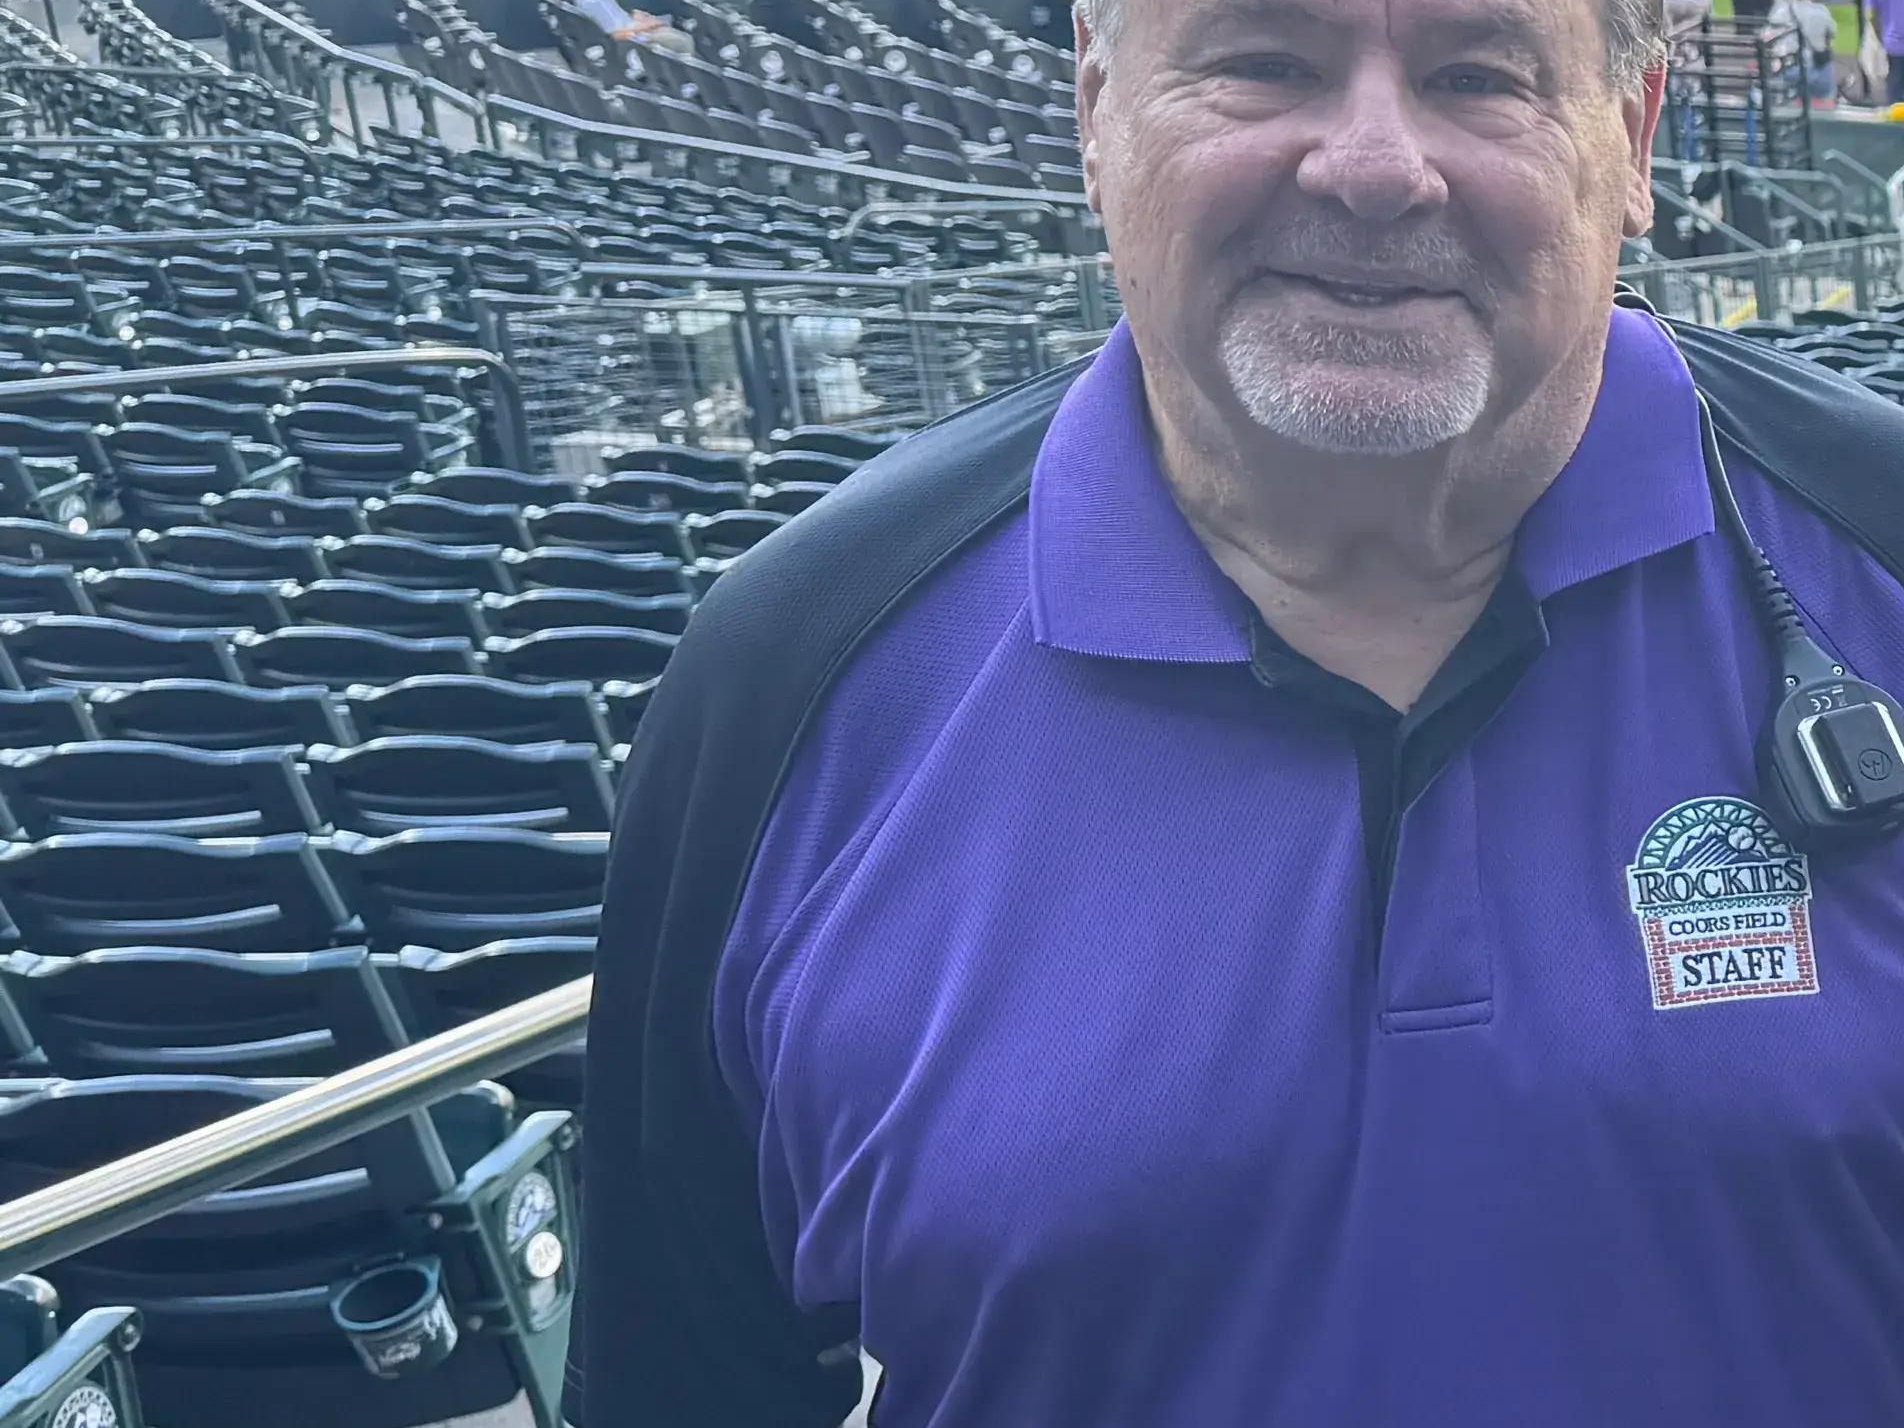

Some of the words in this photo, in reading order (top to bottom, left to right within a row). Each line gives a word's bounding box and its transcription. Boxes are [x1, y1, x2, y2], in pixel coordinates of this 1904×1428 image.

[1634, 859, 1808, 906] ROCKIES
[1668, 915, 1730, 936] COORS
[1734, 911, 1787, 931] FIELD
[1682, 946, 1787, 988] STAFF
